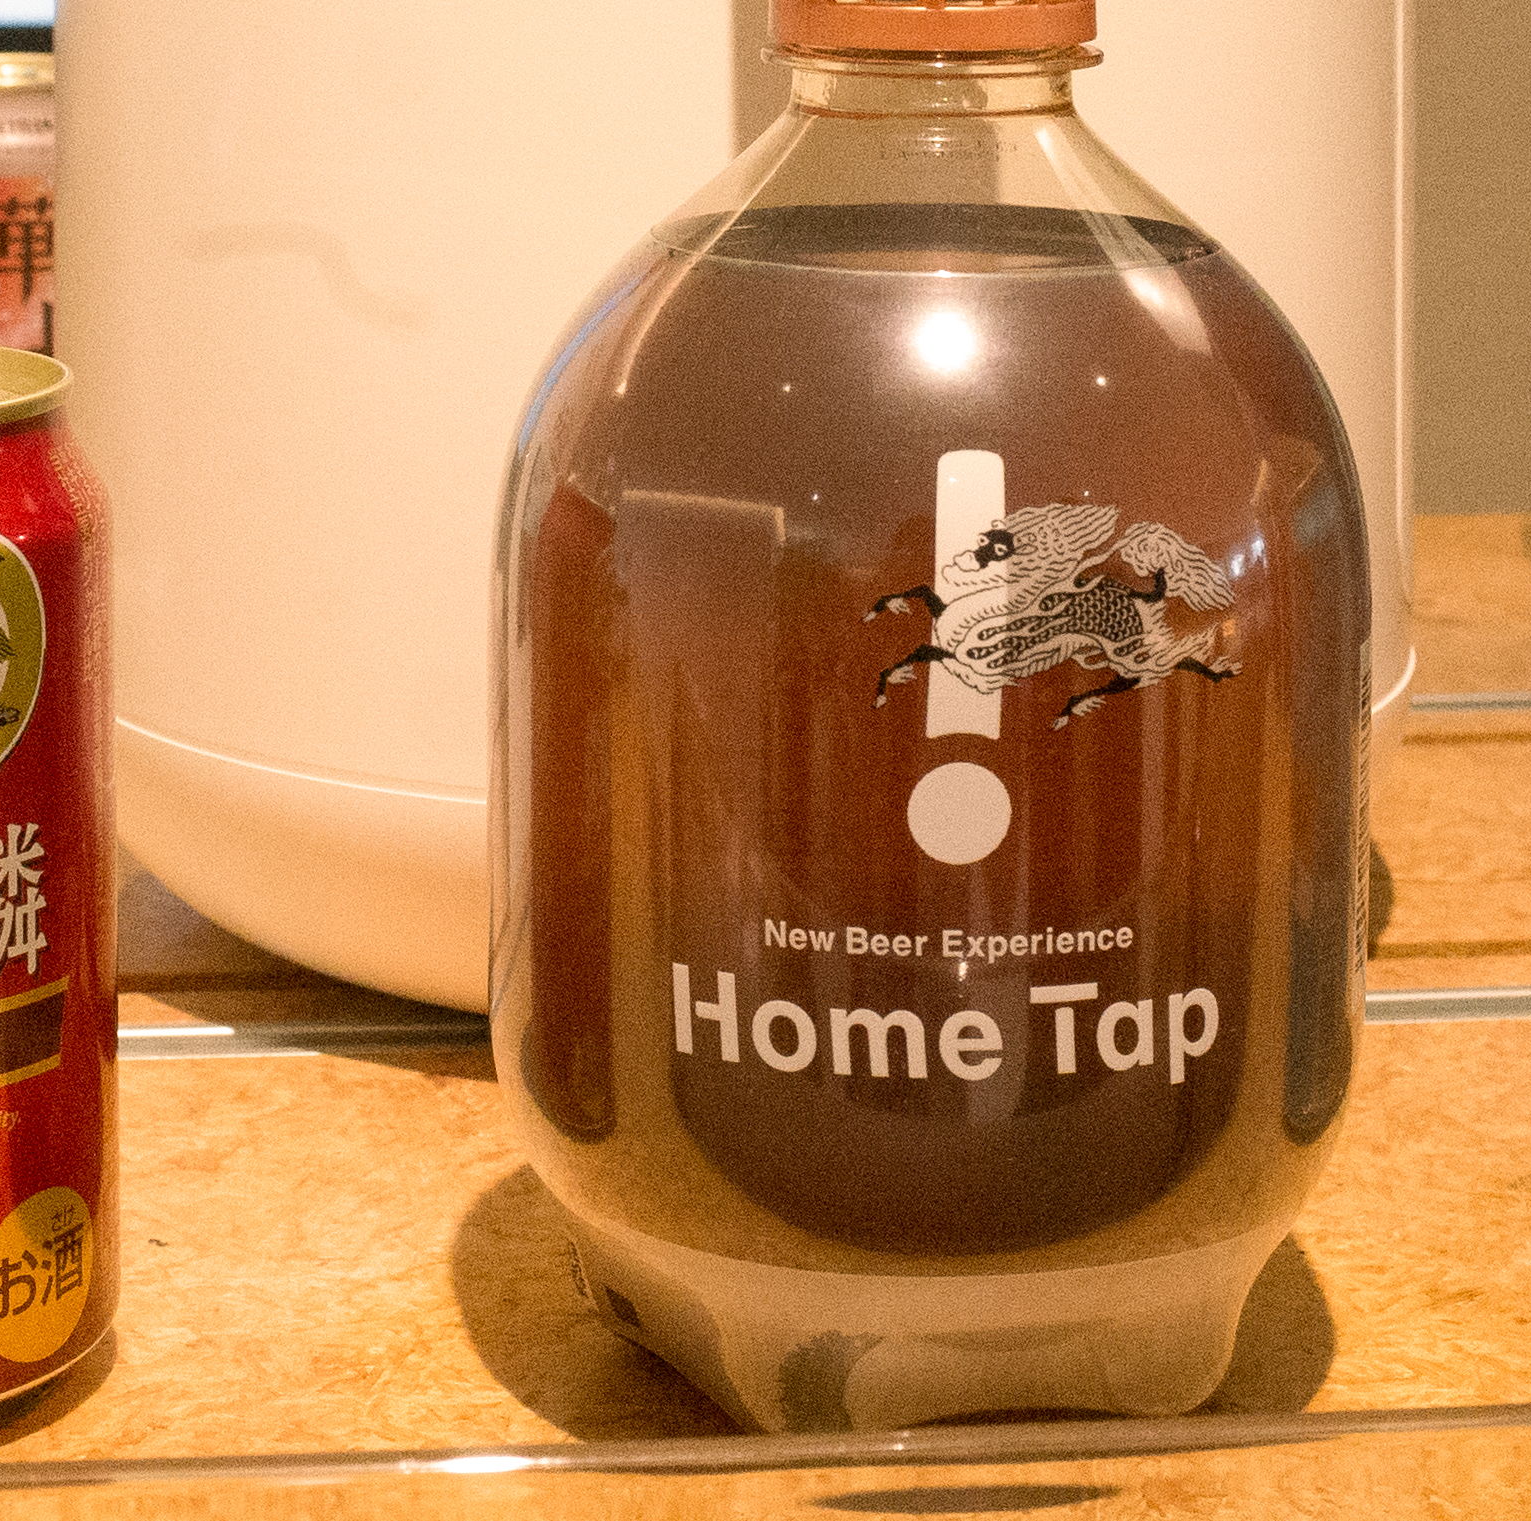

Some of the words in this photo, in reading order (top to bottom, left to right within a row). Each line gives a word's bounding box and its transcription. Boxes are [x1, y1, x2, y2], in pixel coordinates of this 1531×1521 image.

[765, 918, 834, 953] New
[846, 925, 928, 959] Beer
[942, 924, 1134, 963] Experience
[671, 962, 1005, 1082] Home
[1030, 981, 1219, 1085] Tap
